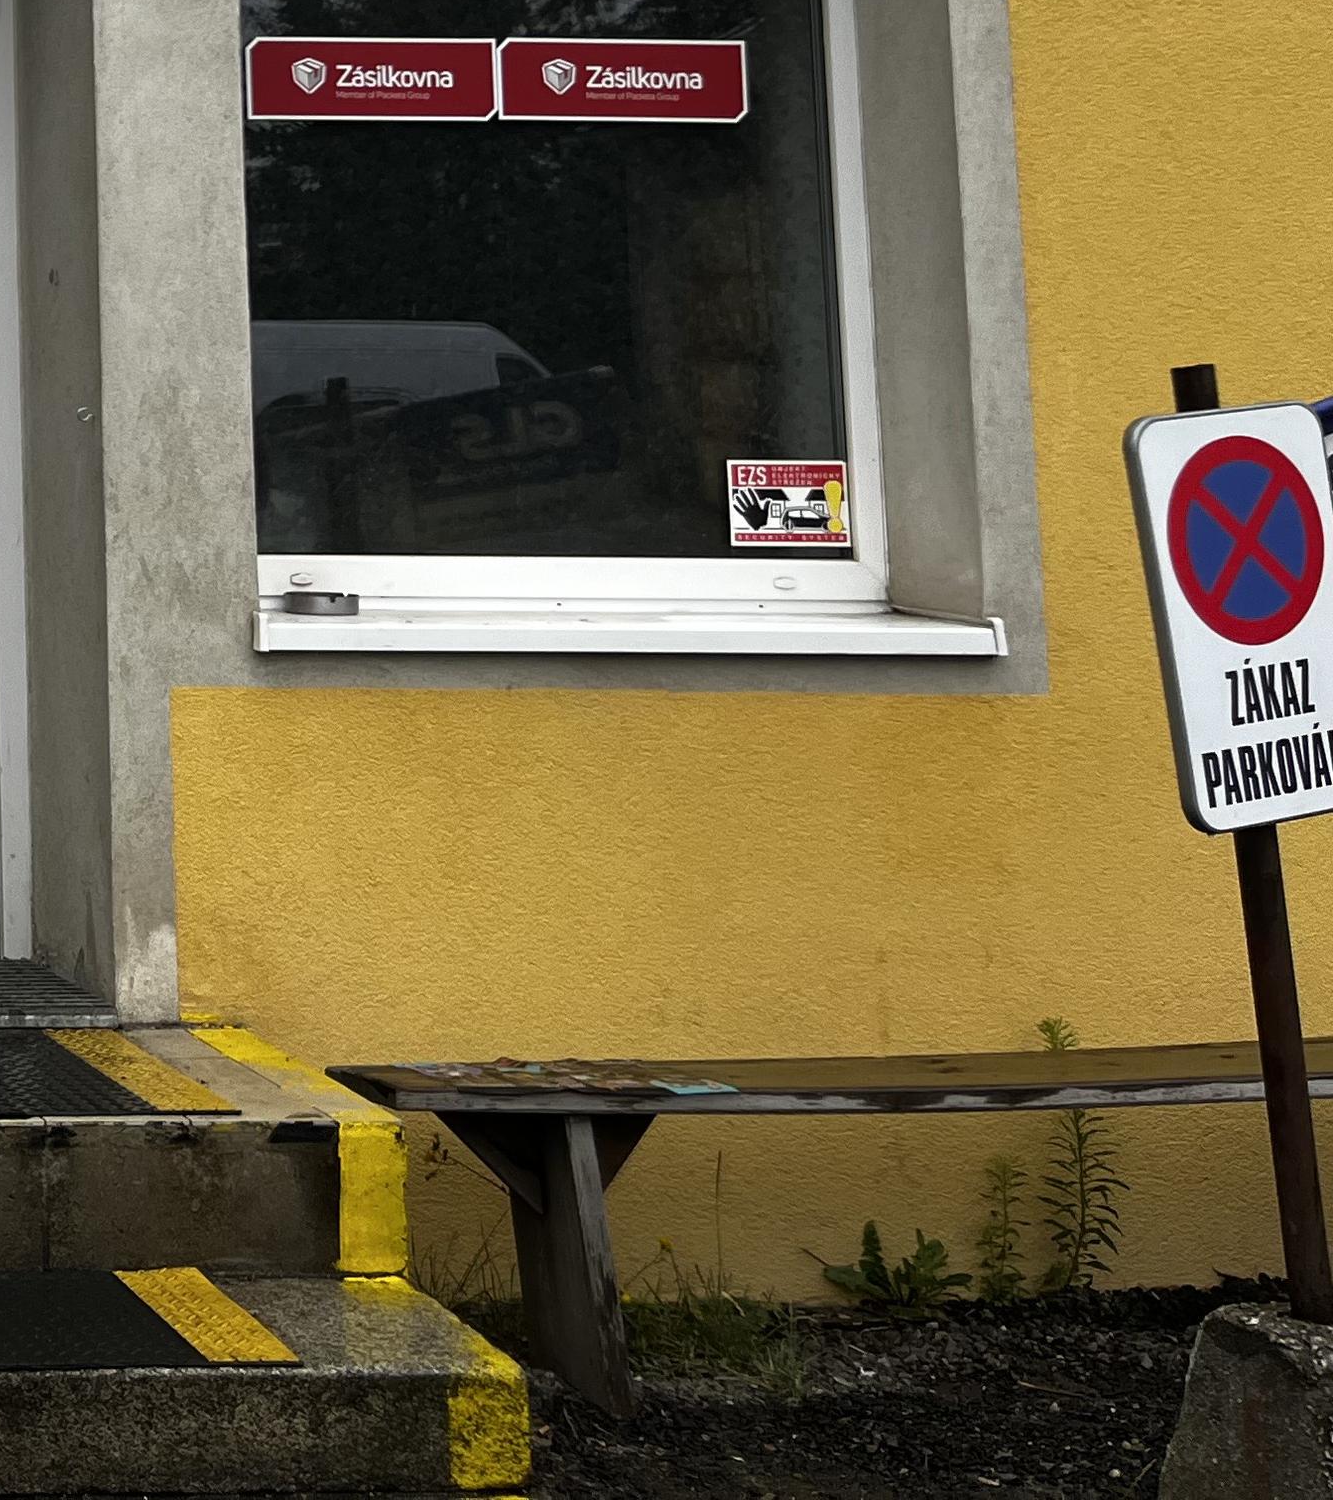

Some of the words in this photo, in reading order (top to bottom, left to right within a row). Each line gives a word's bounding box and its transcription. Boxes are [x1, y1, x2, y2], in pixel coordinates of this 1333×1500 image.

[336, 64, 454, 88] Zásilkovna
[585, 66, 703, 90] Zásilkovna
[737, 465, 767, 485] EZS
[1225, 658, 1315, 726] ZÁKAZ
